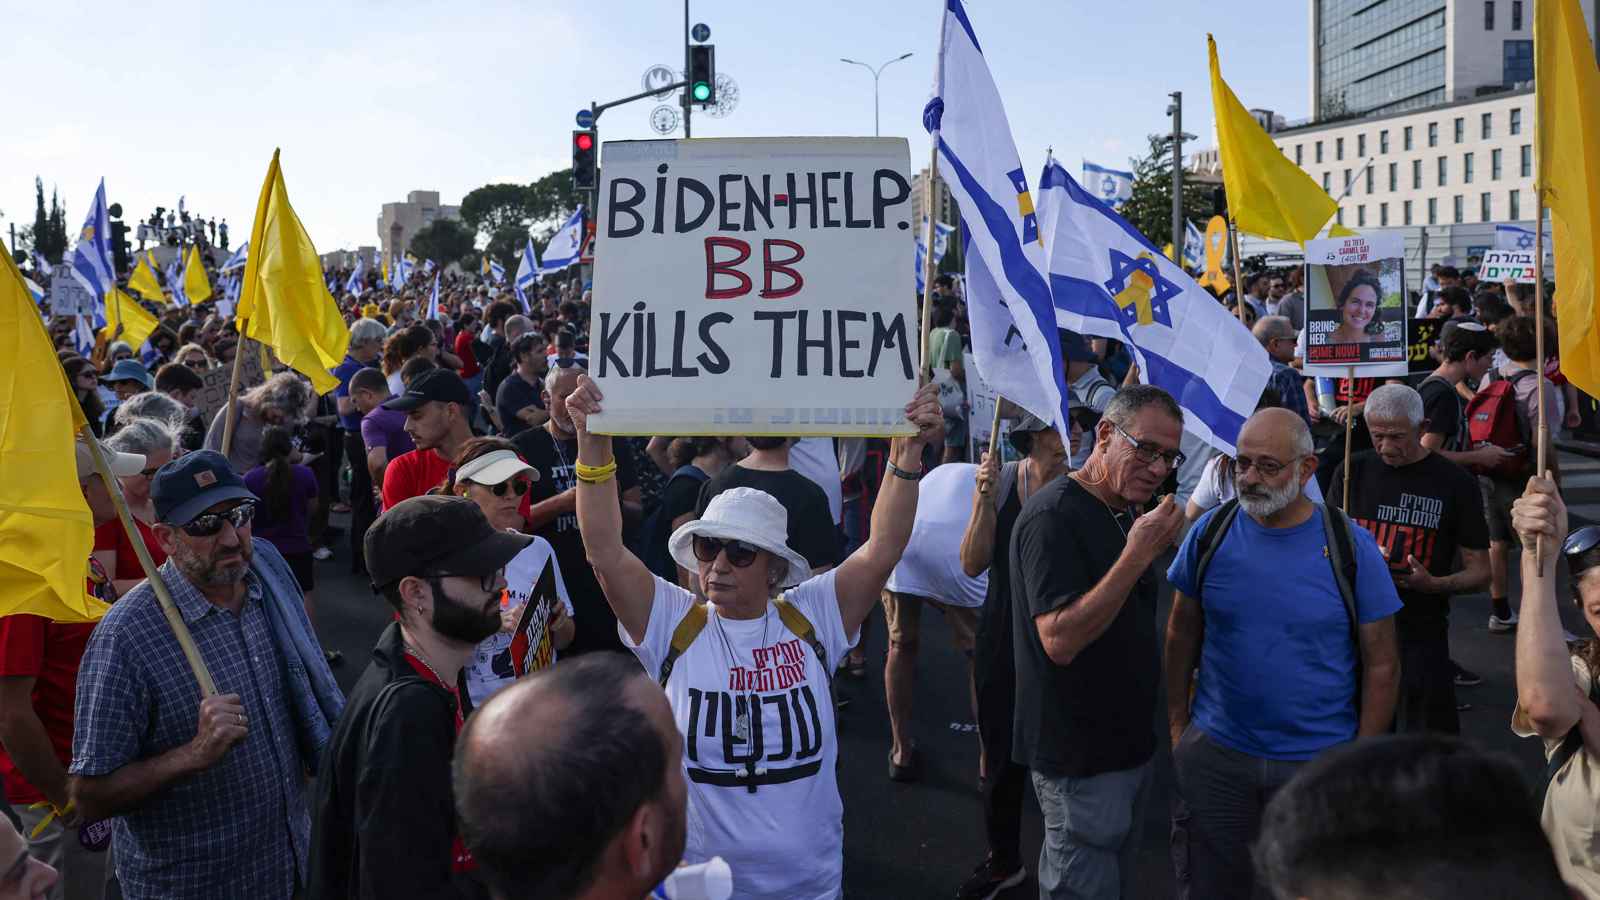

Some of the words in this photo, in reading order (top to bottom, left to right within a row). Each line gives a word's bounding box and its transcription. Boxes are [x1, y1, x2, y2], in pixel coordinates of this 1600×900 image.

[704, 236, 805, 299] BB
[1487, 253, 1536, 265] בחרת
[1480, 266, 1537, 279] בחיים!
[1309, 320, 1335, 333] BRING
[753, 309, 915, 380] THEM
[1309, 333, 1326, 345] HER
[1309, 346, 1334, 358] HOME
[1335, 343, 1360, 358] NOW!
[1399, 492, 1443, 516] מחזירים
[1377, 503, 1410, 525] הביתה
[1410, 510, 1441, 529] אותם
[687, 685, 823, 764] עכשיו
